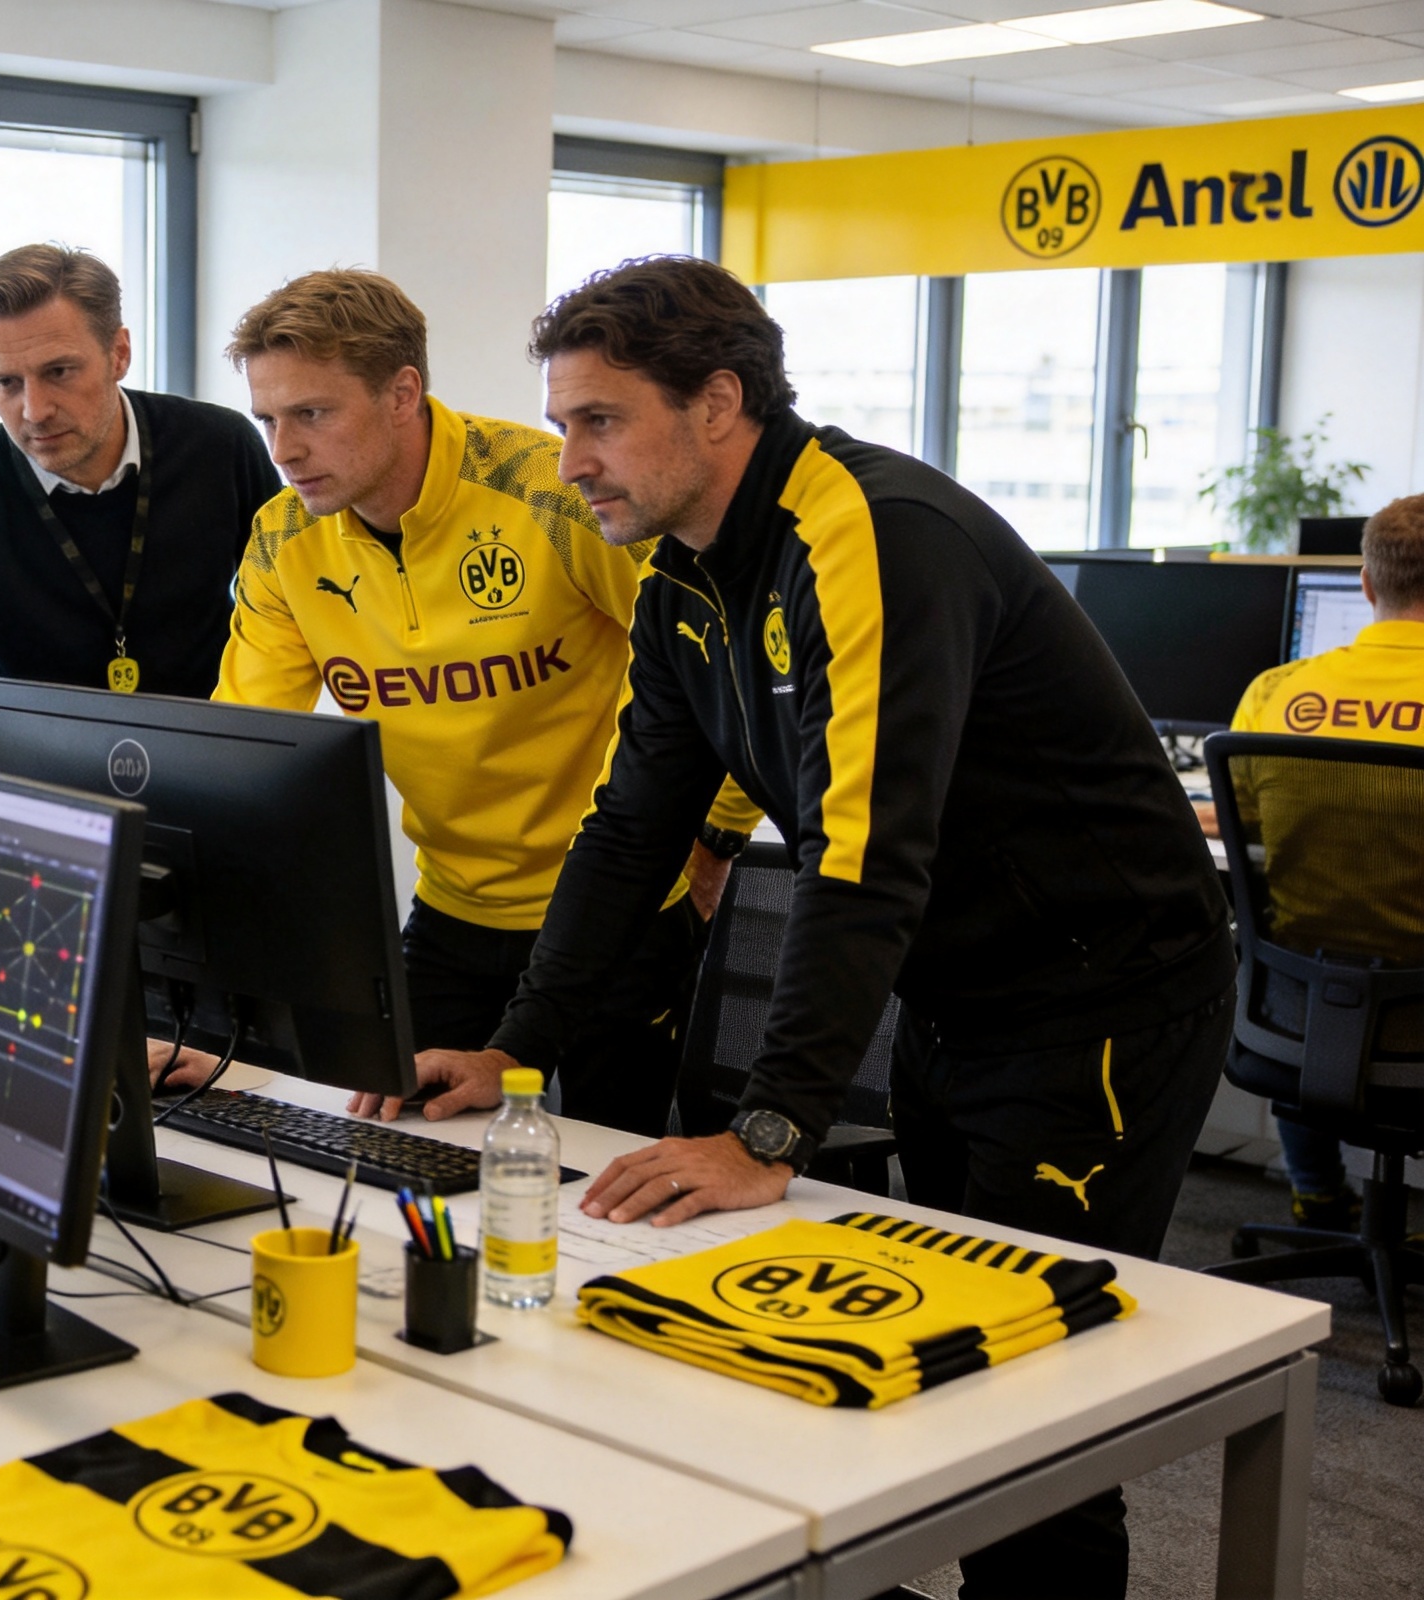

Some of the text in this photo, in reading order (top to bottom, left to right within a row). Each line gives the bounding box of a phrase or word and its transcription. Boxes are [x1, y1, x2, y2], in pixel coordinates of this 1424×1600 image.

[1016, 168, 1090, 230] BVB
[1037, 227, 1064, 249] 09
[466, 547, 519, 595] BVB
[374, 636, 572, 707] EVONIK
[1331, 699, 1424, 731] EVO
[736, 1262, 903, 1317] BVB
[161, 1482, 296, 1541] BVB
